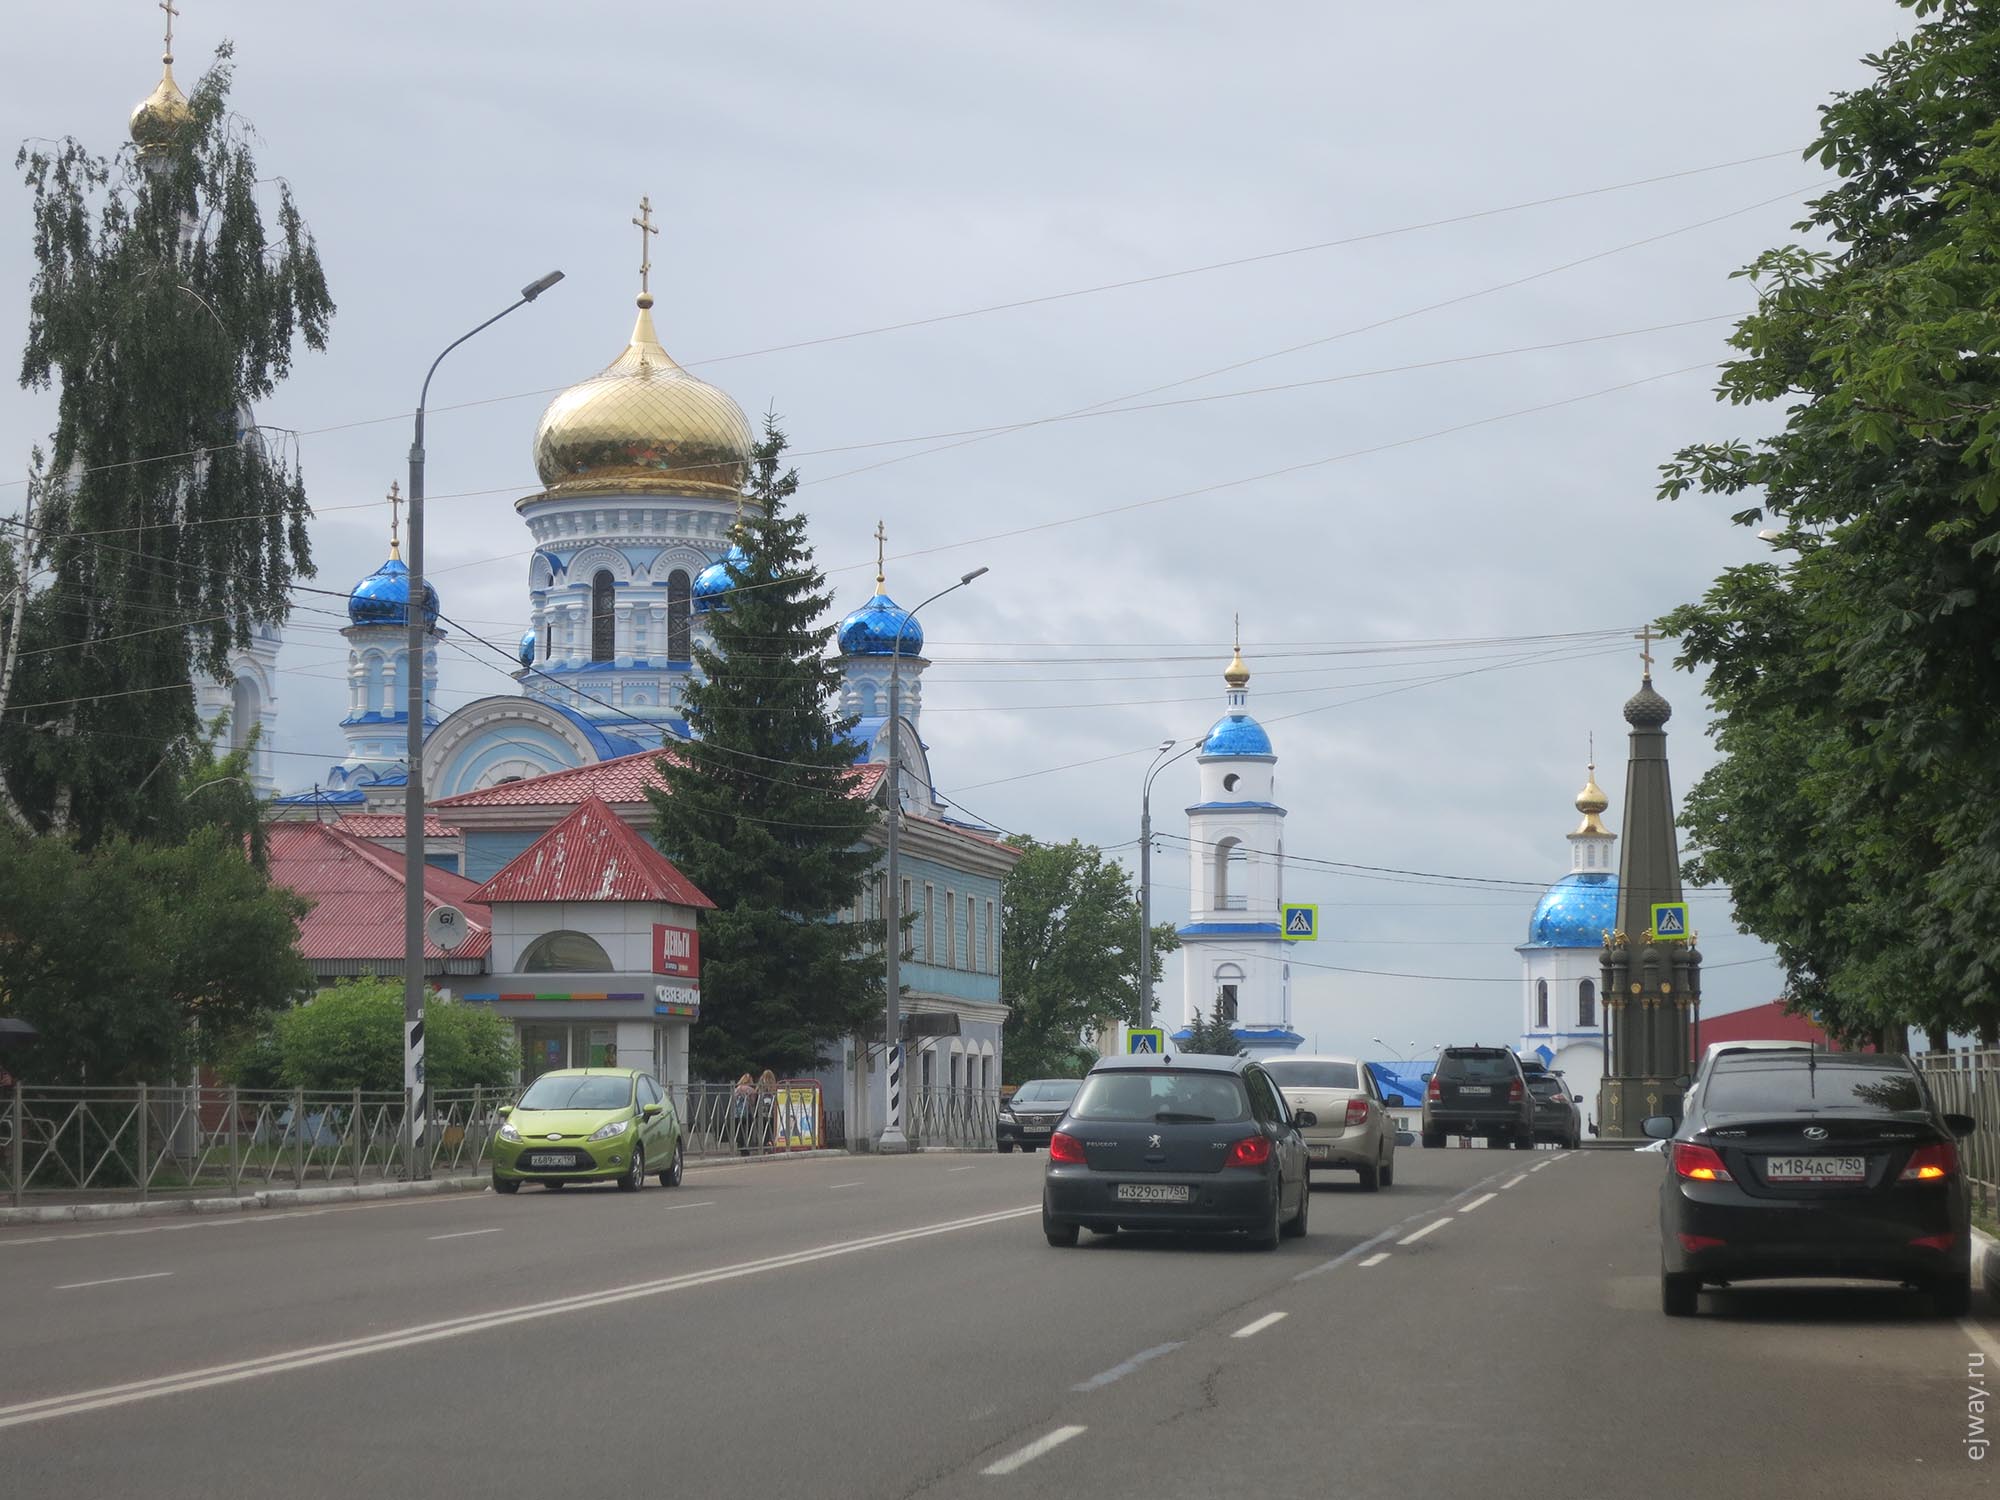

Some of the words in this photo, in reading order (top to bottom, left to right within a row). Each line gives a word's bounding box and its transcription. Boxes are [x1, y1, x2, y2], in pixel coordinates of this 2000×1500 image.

[663, 929, 690, 960] ДЕНЬГИ
[656, 984, 701, 1005] СВЯЗНОЙ
[1211, 1142, 1227, 1150] 307
[1772, 1159, 1834, 1175] М184АС
[1838, 1158, 1861, 1171] 750
[1121, 1185, 1165, 1199] Н329ОТ
[1168, 1186, 1185, 1196] 750
